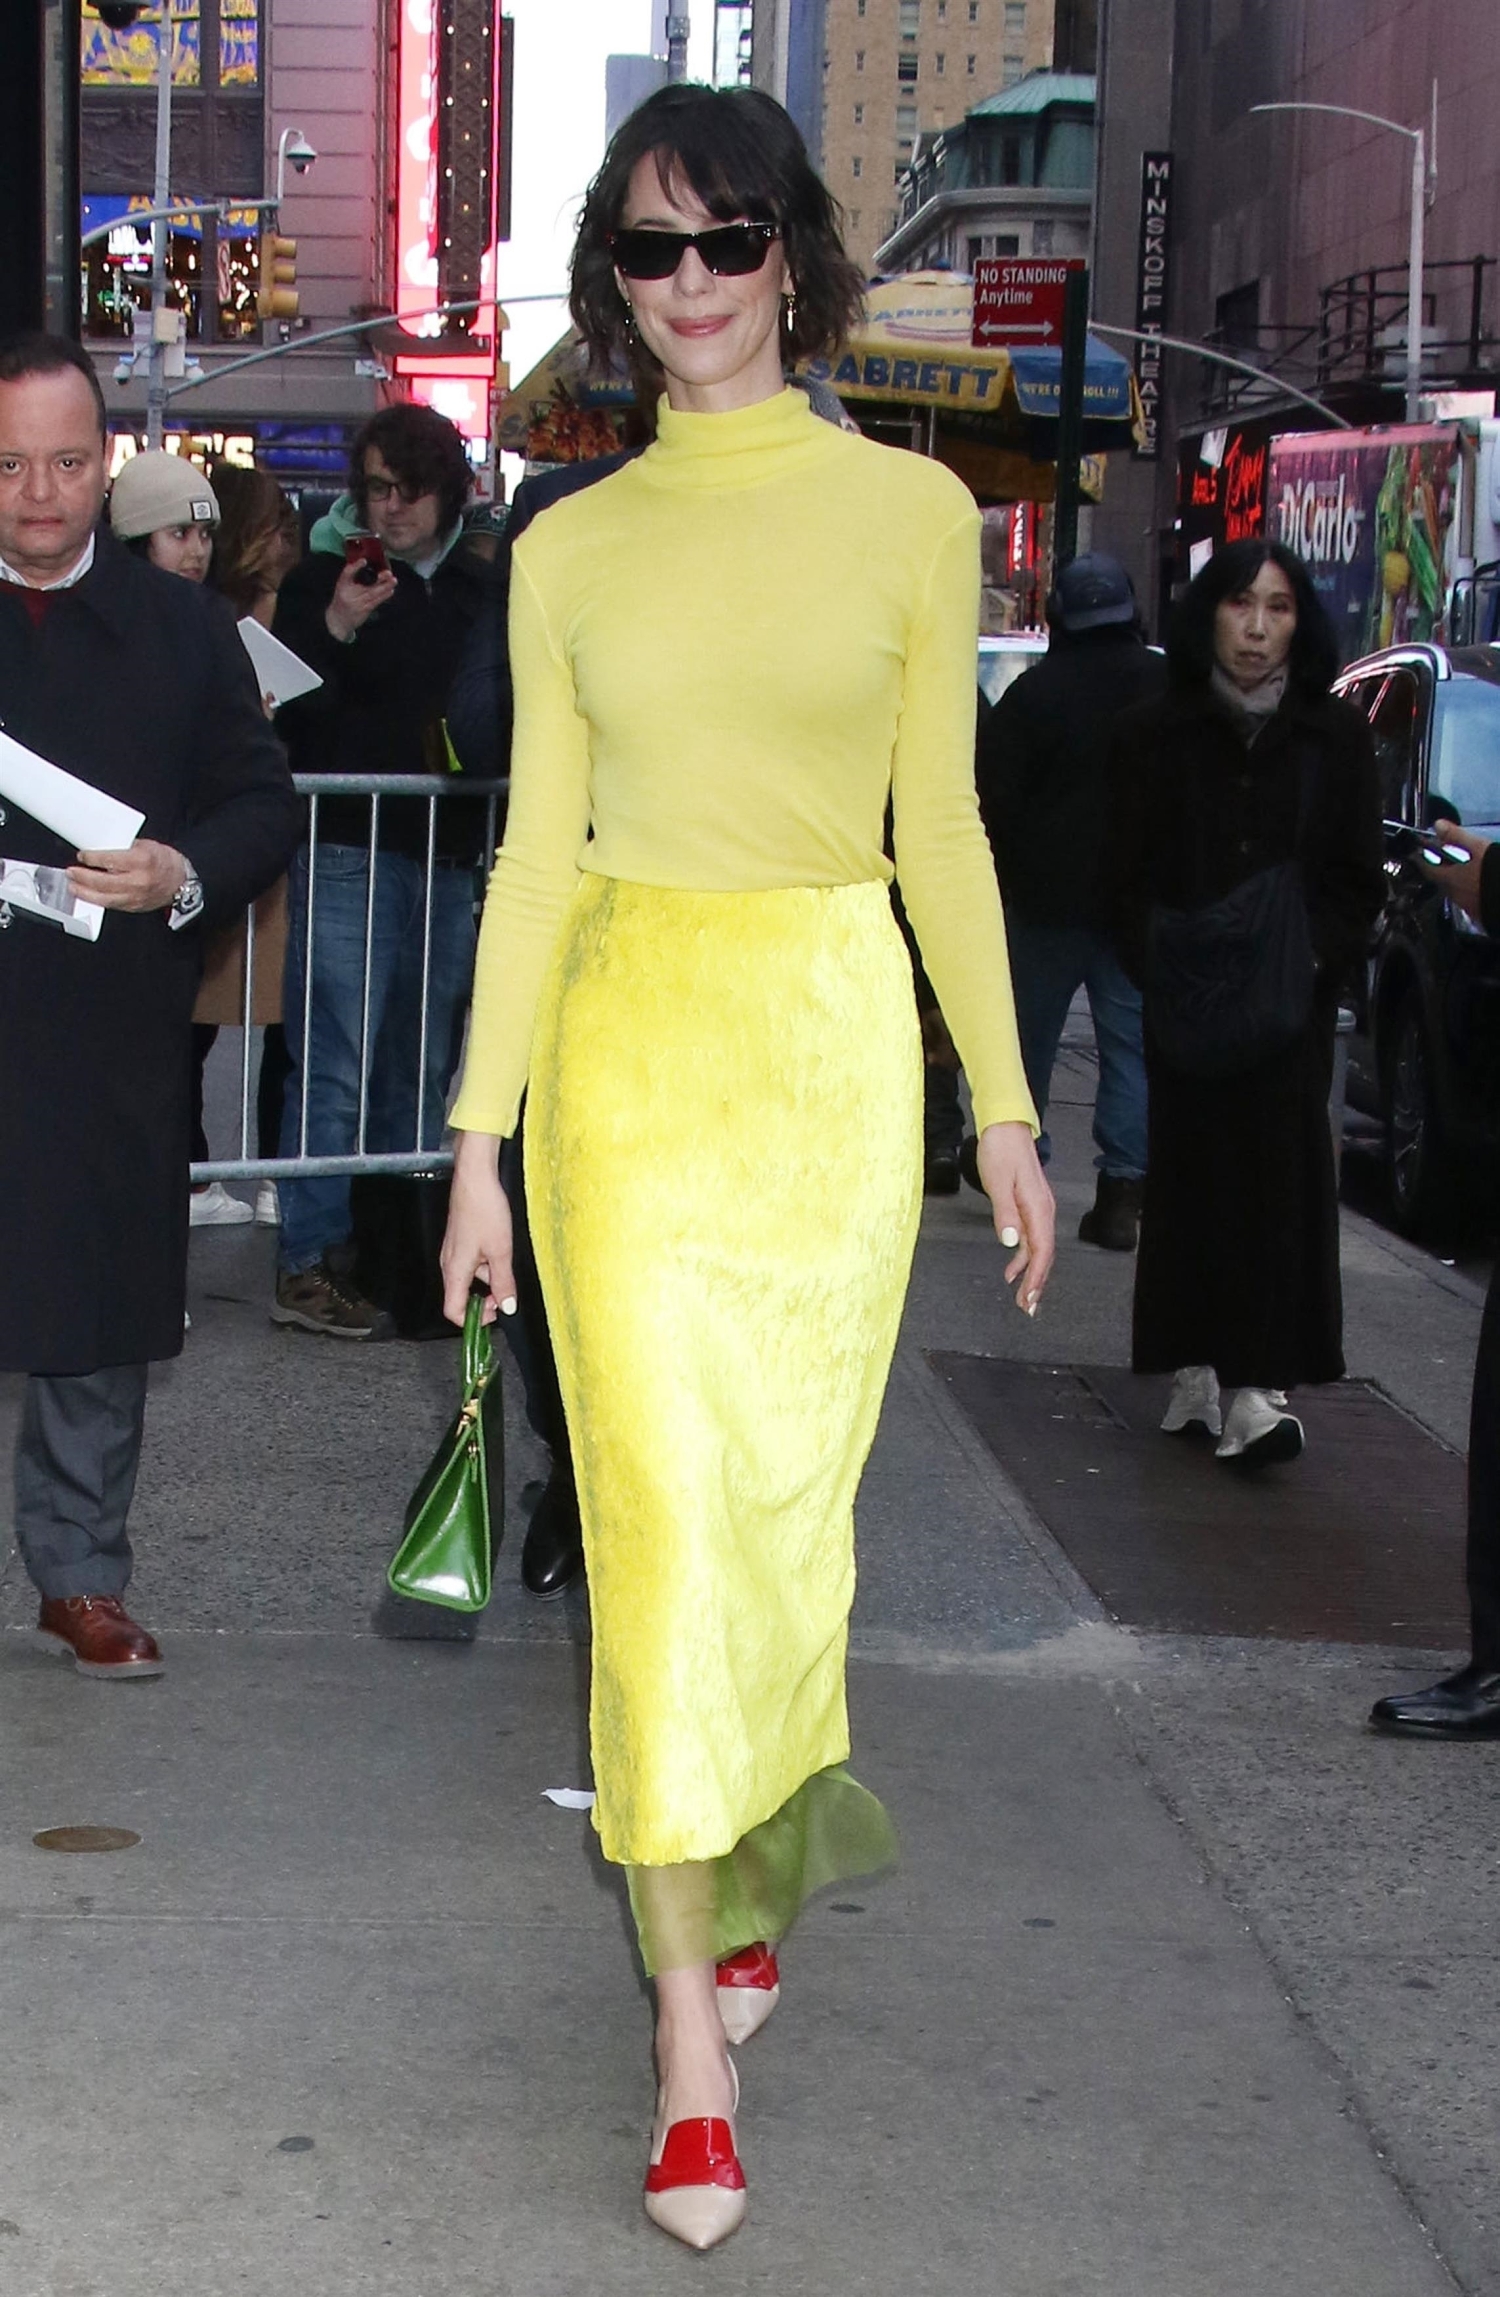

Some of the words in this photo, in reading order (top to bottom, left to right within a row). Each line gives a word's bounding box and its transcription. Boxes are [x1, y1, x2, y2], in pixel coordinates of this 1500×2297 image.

[1142, 161, 1170, 311] MINSKOFF
[979, 288, 1034, 308] Anytime
[980, 267, 999, 284] NO
[1002, 266, 1067, 284] STANDING
[808, 354, 998, 398] SABRETT
[1137, 322, 1160, 454] THEATRE
[1277, 473, 1357, 563] DiCarlo
